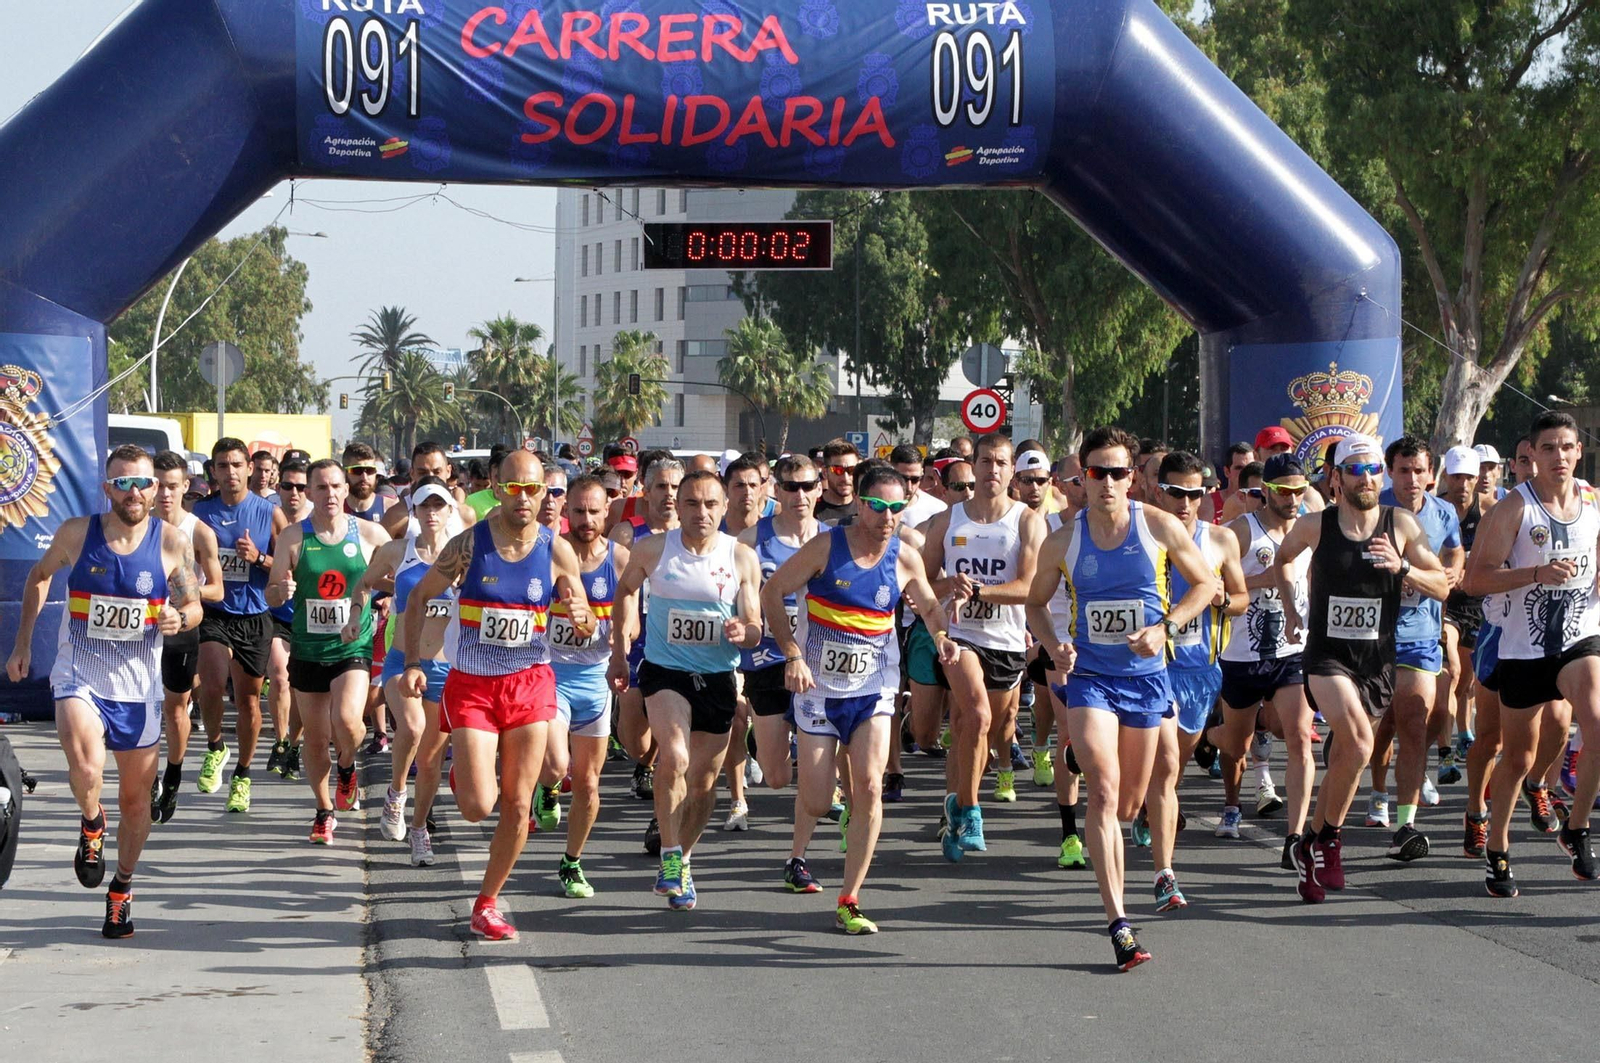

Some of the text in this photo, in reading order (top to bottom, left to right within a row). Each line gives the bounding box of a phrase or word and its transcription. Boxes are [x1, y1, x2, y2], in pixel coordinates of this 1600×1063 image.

[927, 2, 1026, 26] RUTA
[460, 7, 799, 64] CARRERA
[324, 16, 419, 117] 091
[931, 29, 1022, 127] 091
[521, 91, 896, 148] SOLIDARIA
[324, 136, 376, 147] Agrupación
[328, 147, 371, 157] Deportiva
[976, 145, 1025, 156] Agrupación
[979, 157, 1019, 165] Deportiva
[687, 232, 810, 260] 0:00:02
[970, 403, 997, 418] 40
[218, 554, 247, 573] 244
[955, 557, 1006, 576] CNP
[93, 604, 141, 629] 3203
[310, 605, 344, 624] 4041
[963, 600, 1001, 619] 3281
[1091, 609, 1137, 633] 3251
[1332, 605, 1376, 628] 3283
[485, 616, 529, 641] 3204
[672, 618, 714, 641] 3301
[825, 649, 868, 674] 3205
